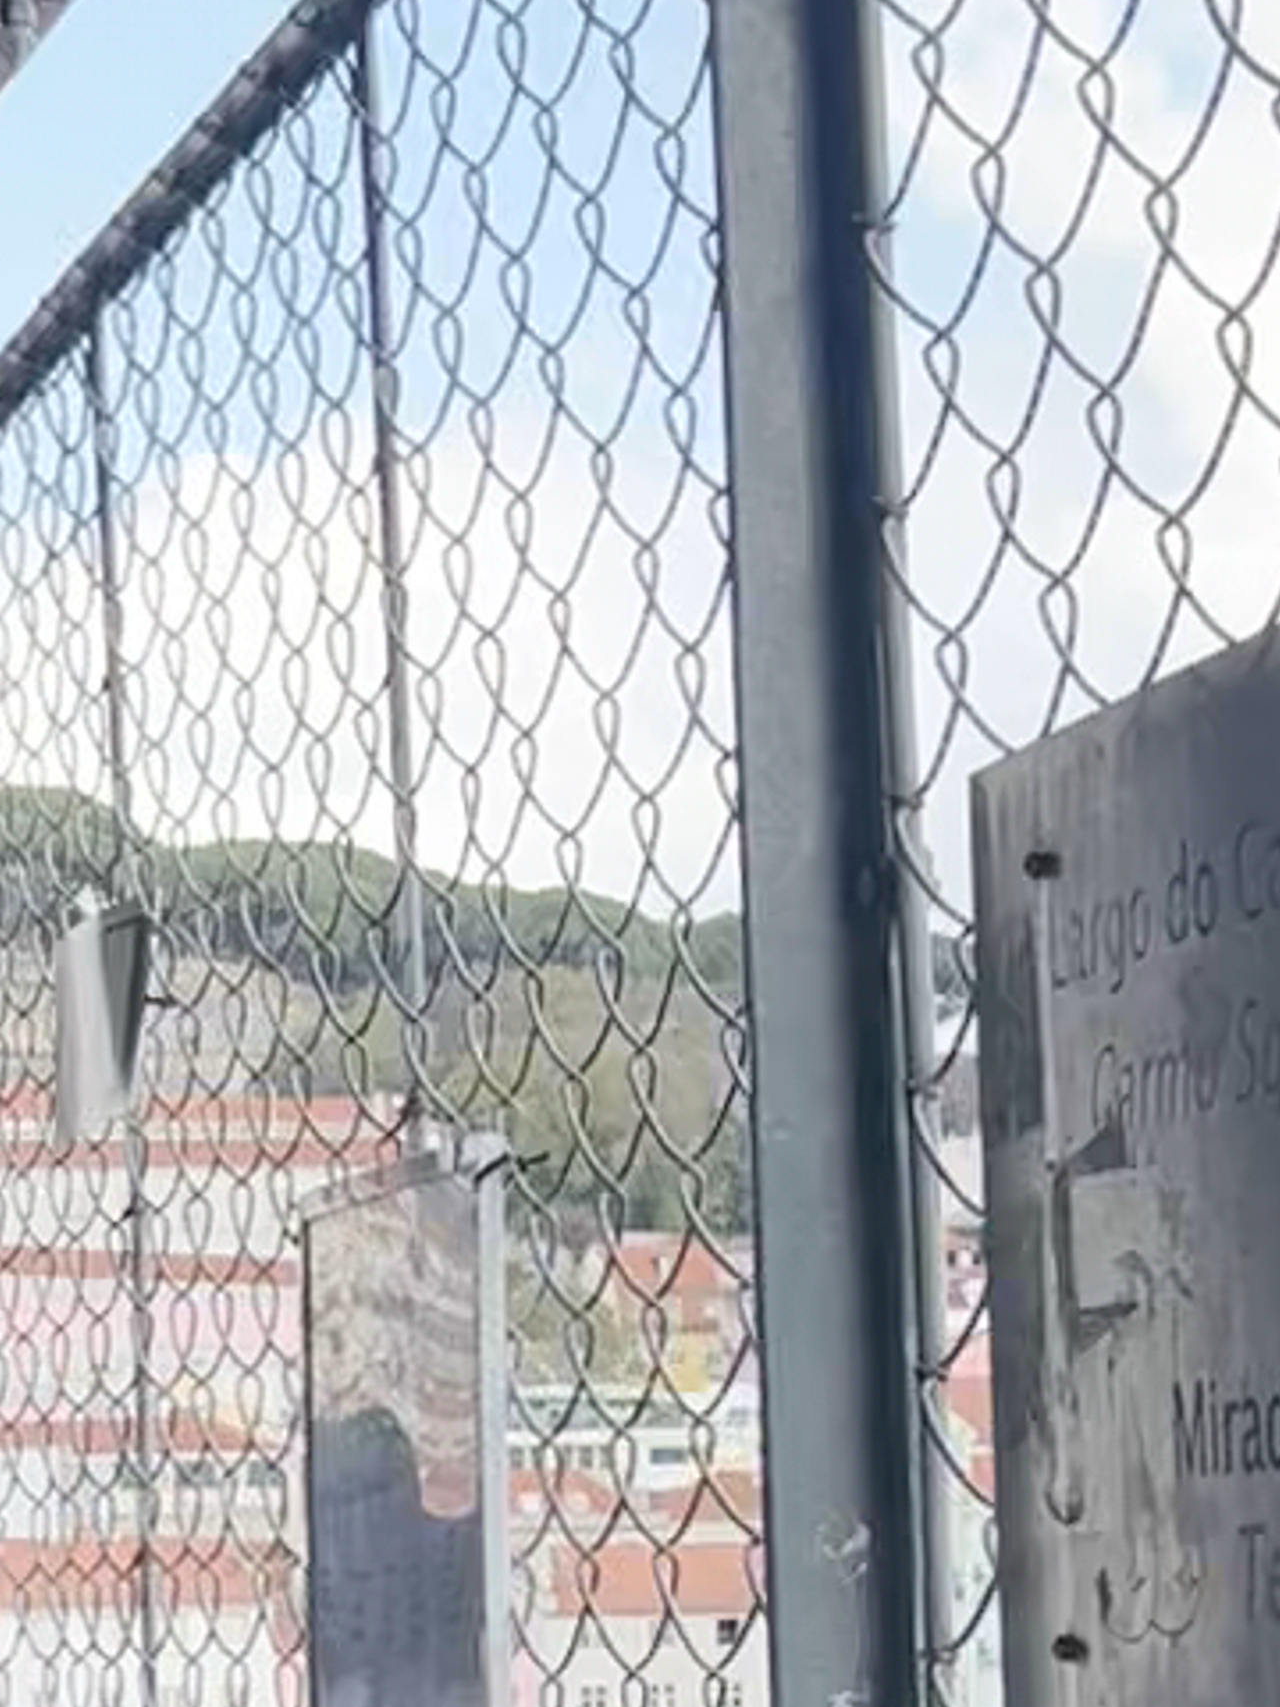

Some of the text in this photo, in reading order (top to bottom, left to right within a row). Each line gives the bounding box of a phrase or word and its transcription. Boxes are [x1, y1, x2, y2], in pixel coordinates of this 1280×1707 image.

[1050, 883, 1148, 994] Largo
[1166, 836, 1218, 946] do
[1091, 1043, 1219, 1131] Carmo
